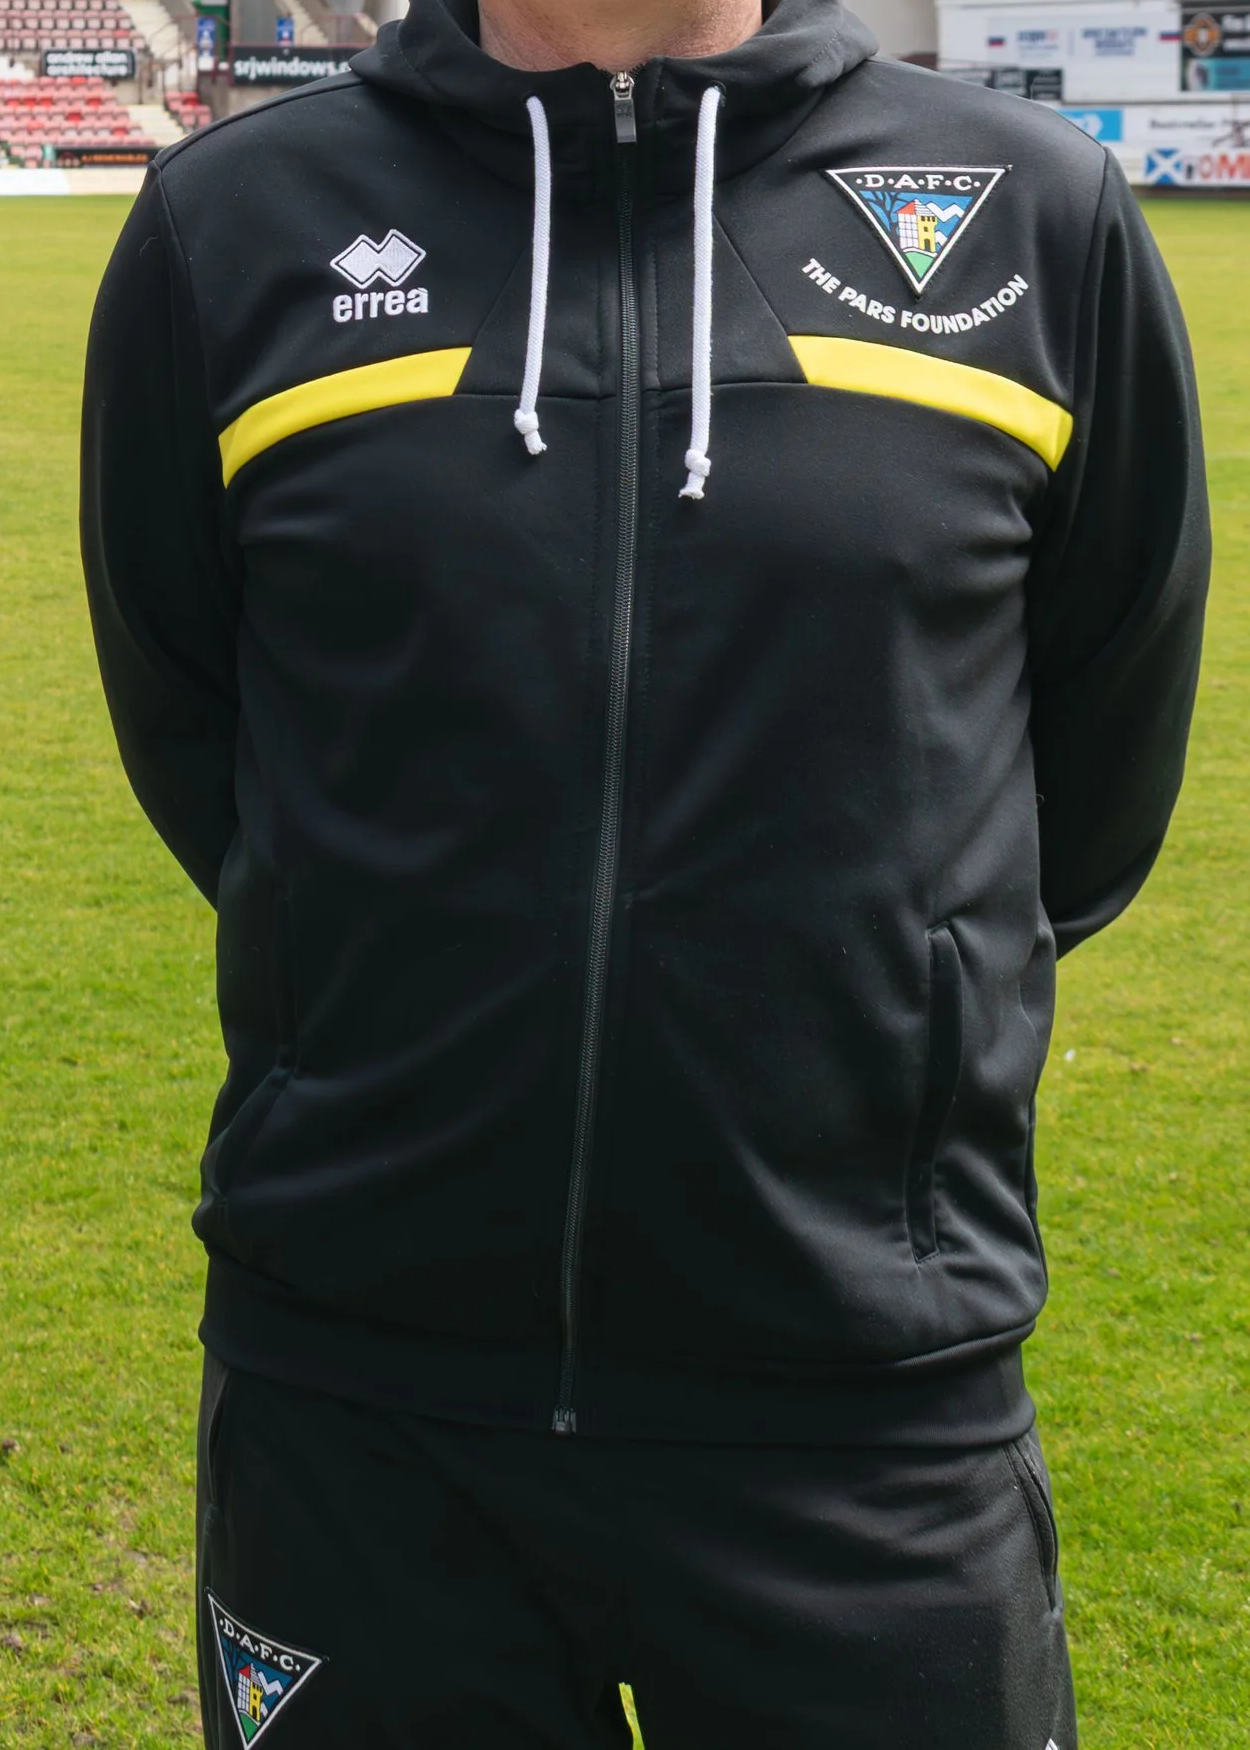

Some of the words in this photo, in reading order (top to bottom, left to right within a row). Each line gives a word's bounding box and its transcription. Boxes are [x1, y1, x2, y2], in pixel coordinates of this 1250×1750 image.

[802, 258, 841, 294] THE
[838, 286, 897, 324] PARS
[901, 274, 1029, 334] FOUNDATION
